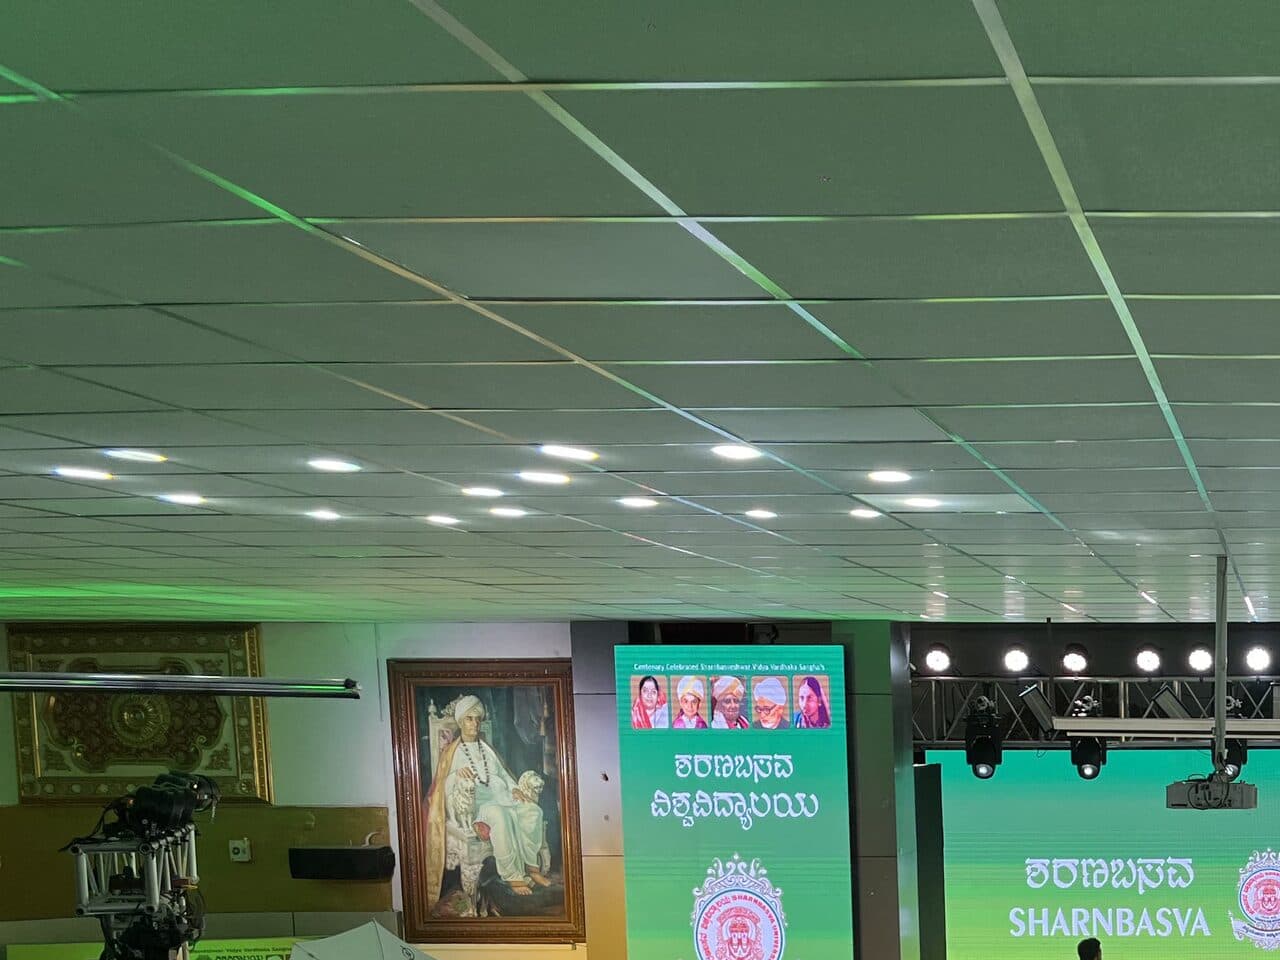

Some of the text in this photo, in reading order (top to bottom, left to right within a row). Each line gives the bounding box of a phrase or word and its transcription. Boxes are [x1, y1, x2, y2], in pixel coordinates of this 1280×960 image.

[675, 753, 794, 783] ಶರಣಬಸವ
[651, 789, 819, 830] ವಿಶ್ವವಿದ್ಯಾಲಯ
[1025, 856, 1195, 895] ಶರಣಬಸವ
[1009, 907, 1212, 937] SHARNBASVA
